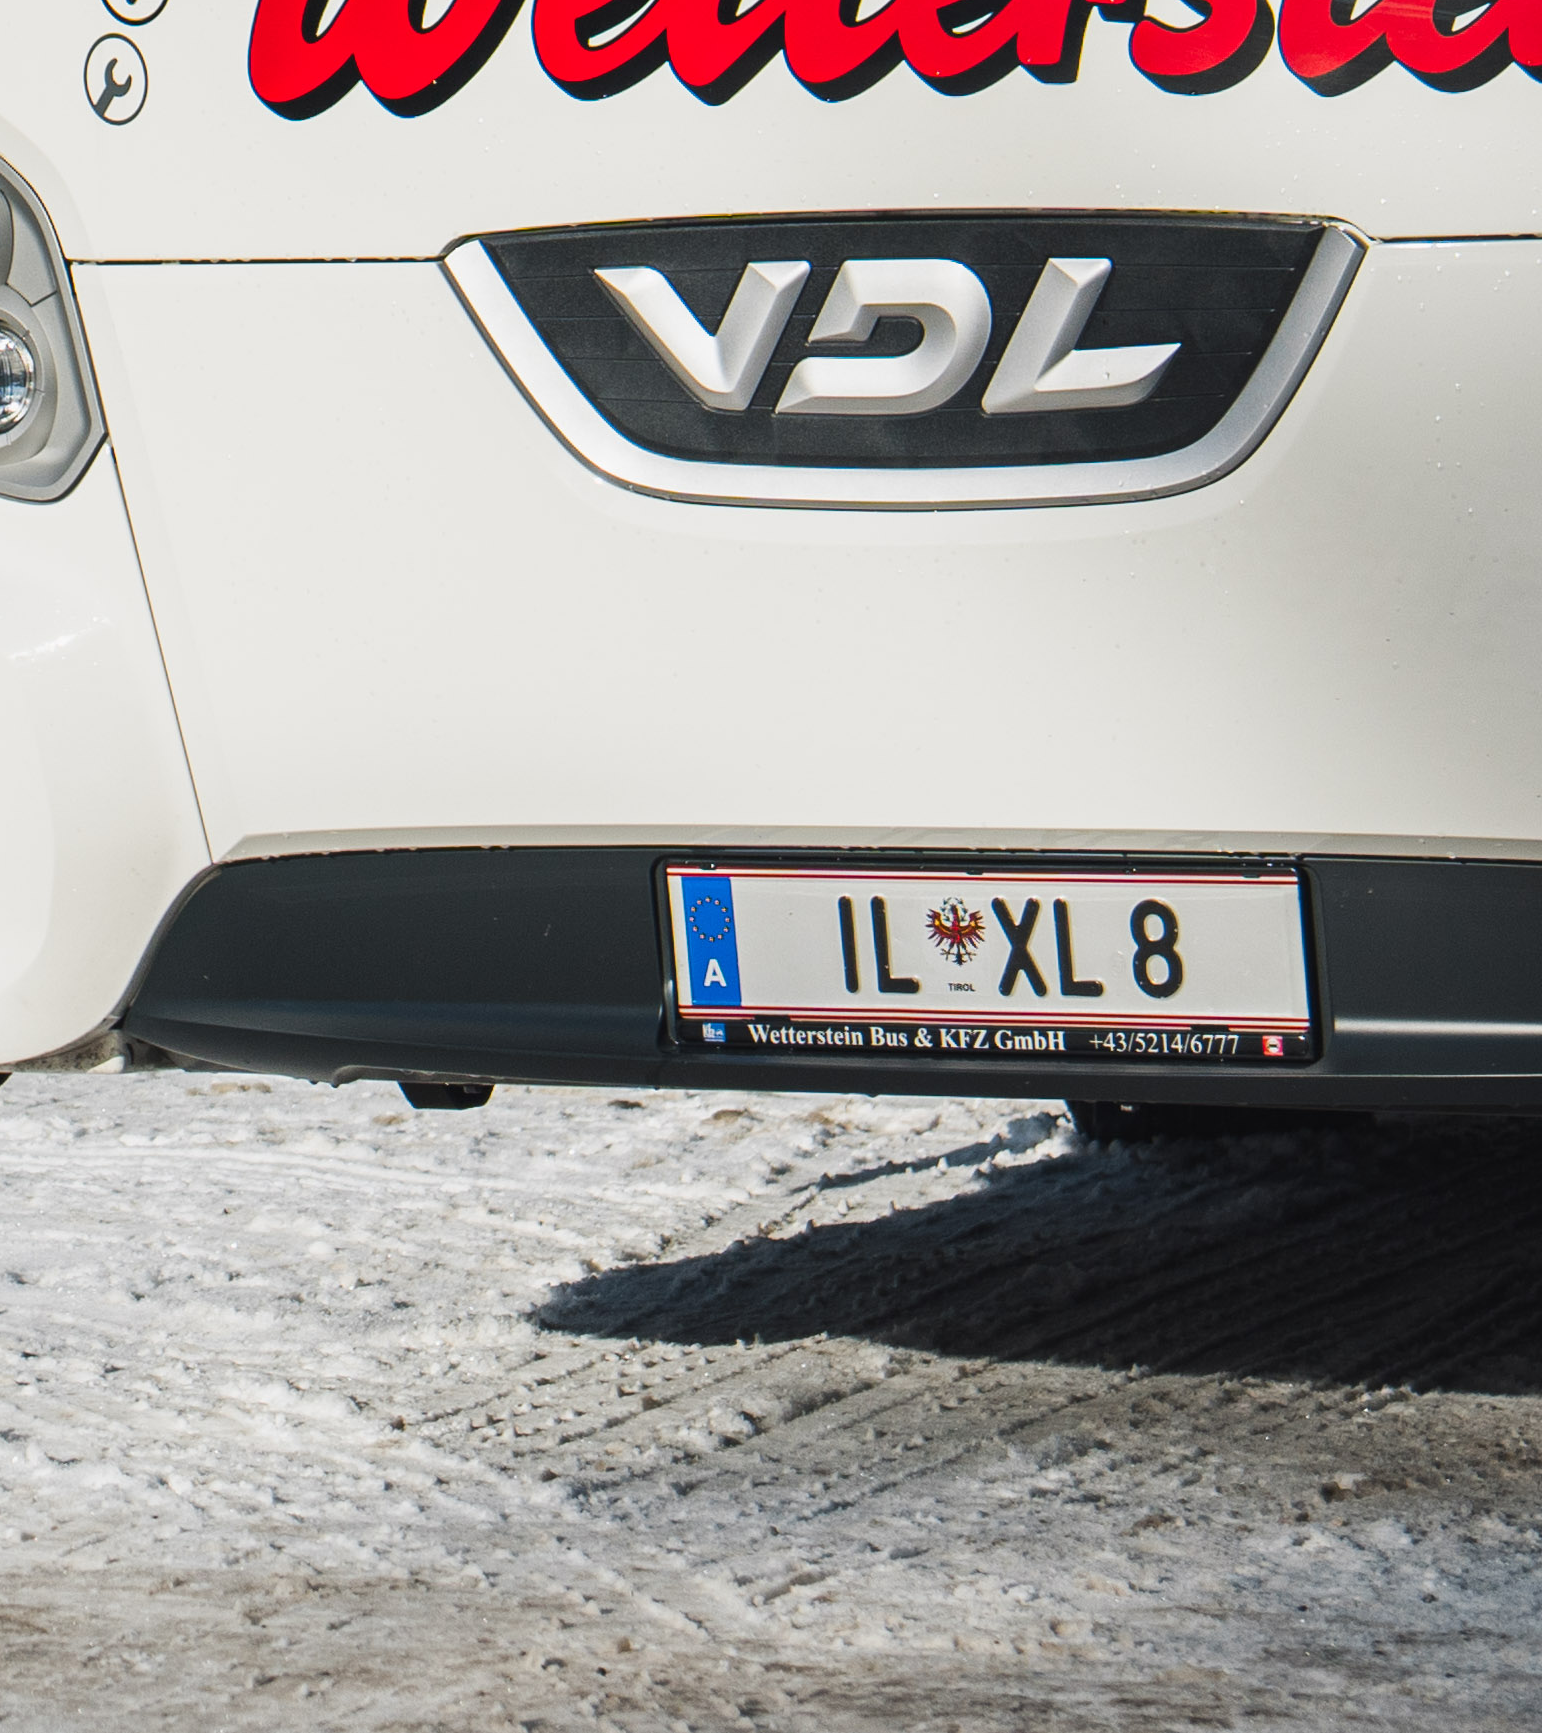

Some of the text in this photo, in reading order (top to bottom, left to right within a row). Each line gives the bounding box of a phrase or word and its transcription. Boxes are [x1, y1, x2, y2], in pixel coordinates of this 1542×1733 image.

[592, 255, 1183, 419] VDL
[838, 895, 1184, 1000] IL XL 8
[703, 959, 727, 988] A
[948, 983, 976, 992] TIROL
[747, 1024, 864, 1046] Wetterstein
[869, 1026, 908, 1047] Bus
[914, 1027, 933, 1048] &
[938, 1028, 990, 1049] KFZ
[994, 1030, 1067, 1051] GmbH
[1089, 1032, 1240, 1054] +43/5214/6777
